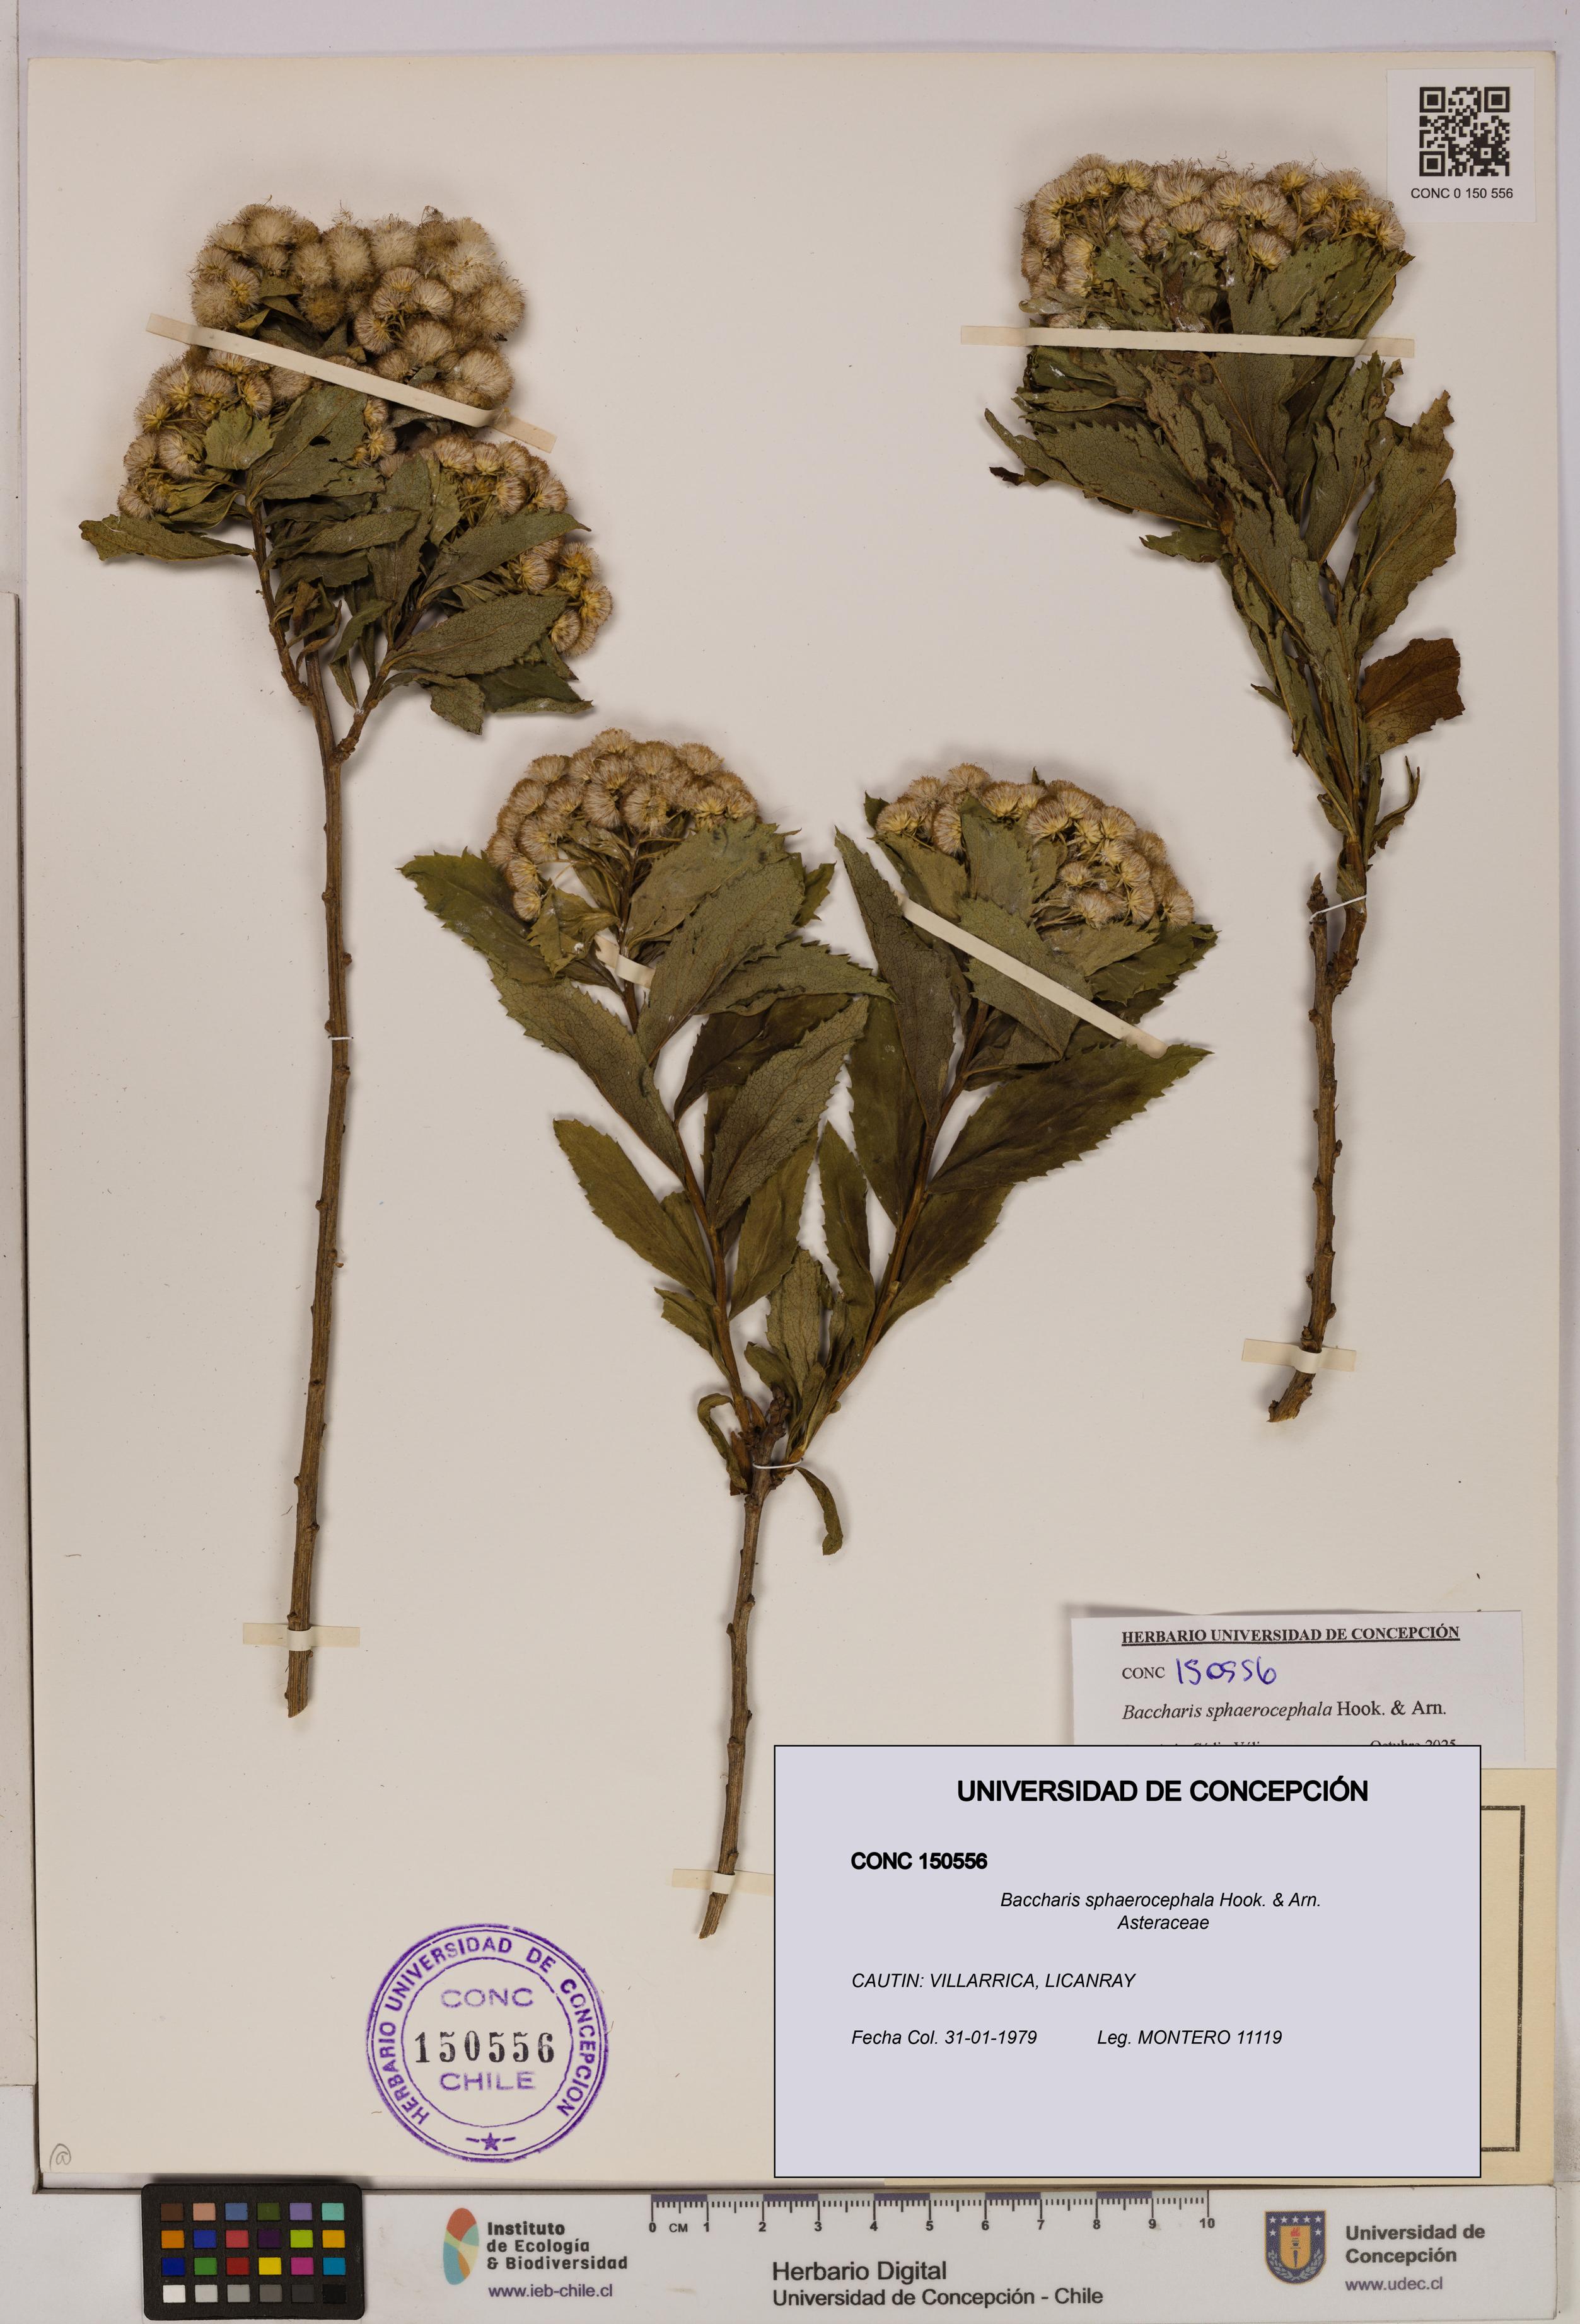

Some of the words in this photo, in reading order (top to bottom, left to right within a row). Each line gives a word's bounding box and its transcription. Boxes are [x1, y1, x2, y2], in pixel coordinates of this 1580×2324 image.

[1410, 187, 1450, 199] CONC
[1453, 187, 1461, 199] 0
[1465, 187, 1487, 199] 150
[1490, 187, 1513, 199] 556
[1122, 1630, 1207, 1643] HERBARIO
[1210, 1628, 1322, 1642] UNIVERSIDAD
[1325, 1627, 1348, 1640] DE
[1351, 1622, 1461, 1640] CONCEPCIÓN
[1122, 1666, 1166, 1680] CONC
[1121, 1703, 1202, 1720] Baccharis
[1205, 1701, 1333, 1722] sphaerocephala
[1336, 1700, 1385, 1716] Hook.
[1390, 1699, 1406, 1716] &
[1411, 1700, 1446, 1715] Arn.
[525, 1946, 557, 1974] DE
[384, 1936, 513, 2012] UNIVERSIDAD
[441, 1987, 534, 2008] CONC
[414, 2030, 555, 2064] 150556
[555, 1978, 597, 2117] CONCEPCION
[378, 2021, 431, 2125] HERBARIO
[439, 2071, 536, 2091] CHILE
[487, 2221, 566, 2236] Instituto
[648, 2221, 657, 2233] 0
[668, 2223, 688, 2234] CM
[702, 2221, 711, 2233] 1
[758, 2221, 767, 2233] 2
[814, 2221, 823, 2233] 3
[869, 2220, 878, 2232] 4
[925, 2220, 934, 2232] 5
[981, 2220, 990, 2232] 6
[1037, 2219, 1045, 2231] 7
[1092, 2219, 1101, 2231] 8
[1147, 2218, 1157, 2230] 9
[1199, 2217, 1216, 2229] 10
[1346, 2224, 1457, 2241] Universidad
[1462, 2224, 1485, 2240] de
[486, 2239, 508, 2253] de
[514, 2238, 590, 2253] Ecología
[487, 2257, 499, 2270] &
[506, 2255, 627, 2270] Biodiversidad
[1345, 2248, 1457, 2267] Concepción
[772, 2261, 869, 2281] Herbario
[877, 2260, 947, 2284] Digital
[488, 2283, 613, 2298] www.ieb-chile.cl
[1345, 2276, 1443, 2291] www.udec.cl
[773, 2289, 886, 2306] Universidad
[892, 2289, 916, 2306] de
[922, 2287, 1035, 2309] Concepción
[1054, 2287, 1103, 2304] Chile
